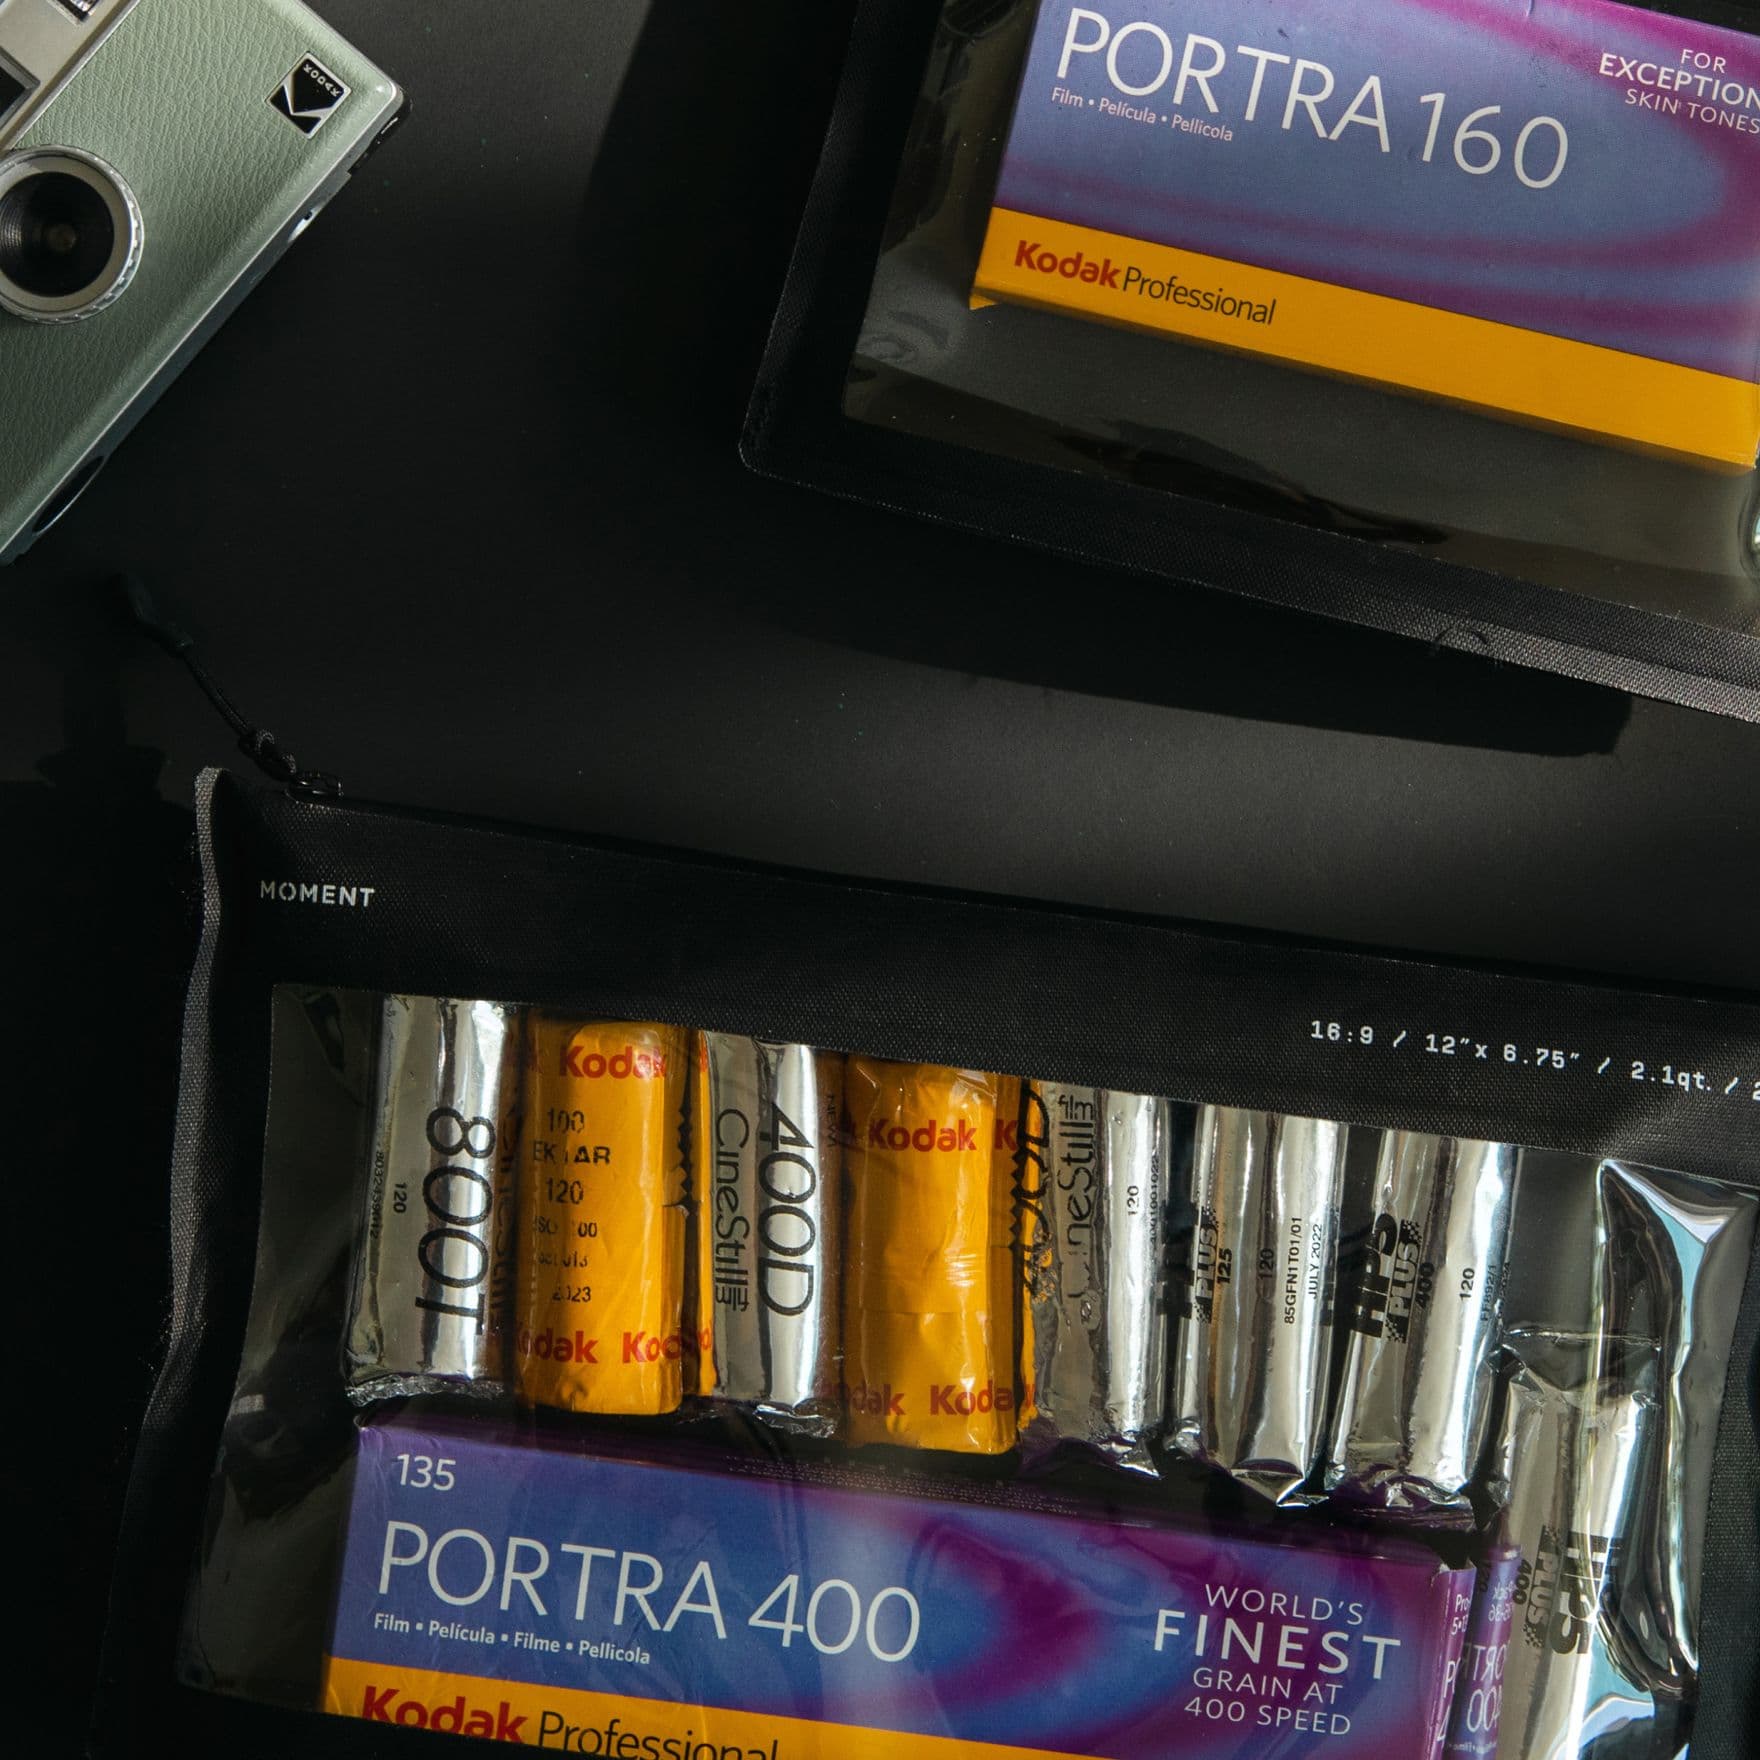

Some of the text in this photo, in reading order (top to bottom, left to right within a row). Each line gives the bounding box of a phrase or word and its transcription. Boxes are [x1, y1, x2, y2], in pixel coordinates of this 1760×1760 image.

[303, 63, 339, 97] KODAK
[1681, 48, 1726, 73] FOR
[1051, 87, 1233, 141] Film Película Pellicola
[1057, 8, 1568, 188] PORTRA 160
[1625, 88, 1760, 134] SKIN TONES
[1014, 240, 1277, 325] Kodak Professional
[260, 880, 375, 907] MOMENT
[560, 1045, 667, 1079] Kodak
[1310, 1020, 1373, 1045] 16:9
[1631, 1061, 1711, 1091] 2.1qt.
[548, 1109, 585, 1134] 100
[868, 1119, 977, 1152] Kodak
[533, 1140, 611, 1164] EKAR
[393, 1182, 407, 1213] 120
[545, 1177, 584, 1205] 120
[715, 1108, 750, 1285] CineStill
[758, 1101, 816, 1316] 400D
[1127, 1185, 1140, 1216] 120
[416, 1107, 495, 1335] 800T
[1196, 1228, 1218, 1298] PLUS
[1217, 1248, 1233, 1284] 125
[1259, 1248, 1275, 1281] 120
[1308, 1223, 1323, 1299] JULY 2022
[1388, 1242, 1419, 1318] PLUS
[1416, 1262, 1435, 1308] 400
[1460, 1268, 1475, 1301] 120
[396, 1453, 457, 1491] 135
[378, 1520, 921, 1663] PORTRA 400
[1512, 1559, 1532, 1604] 400
[1528, 1550, 1558, 1626] PLUS
[1204, 1583, 1364, 1626] WORLD'S
[374, 1613, 651, 1665] Film Película Filme Pellicola
[1153, 1609, 1401, 1680] FINEST
[1193, 1667, 1344, 1705] GRAIN AT
[362, 1685, 529, 1744] Kodak
[1184, 1696, 1352, 1737] 400 SPEED
